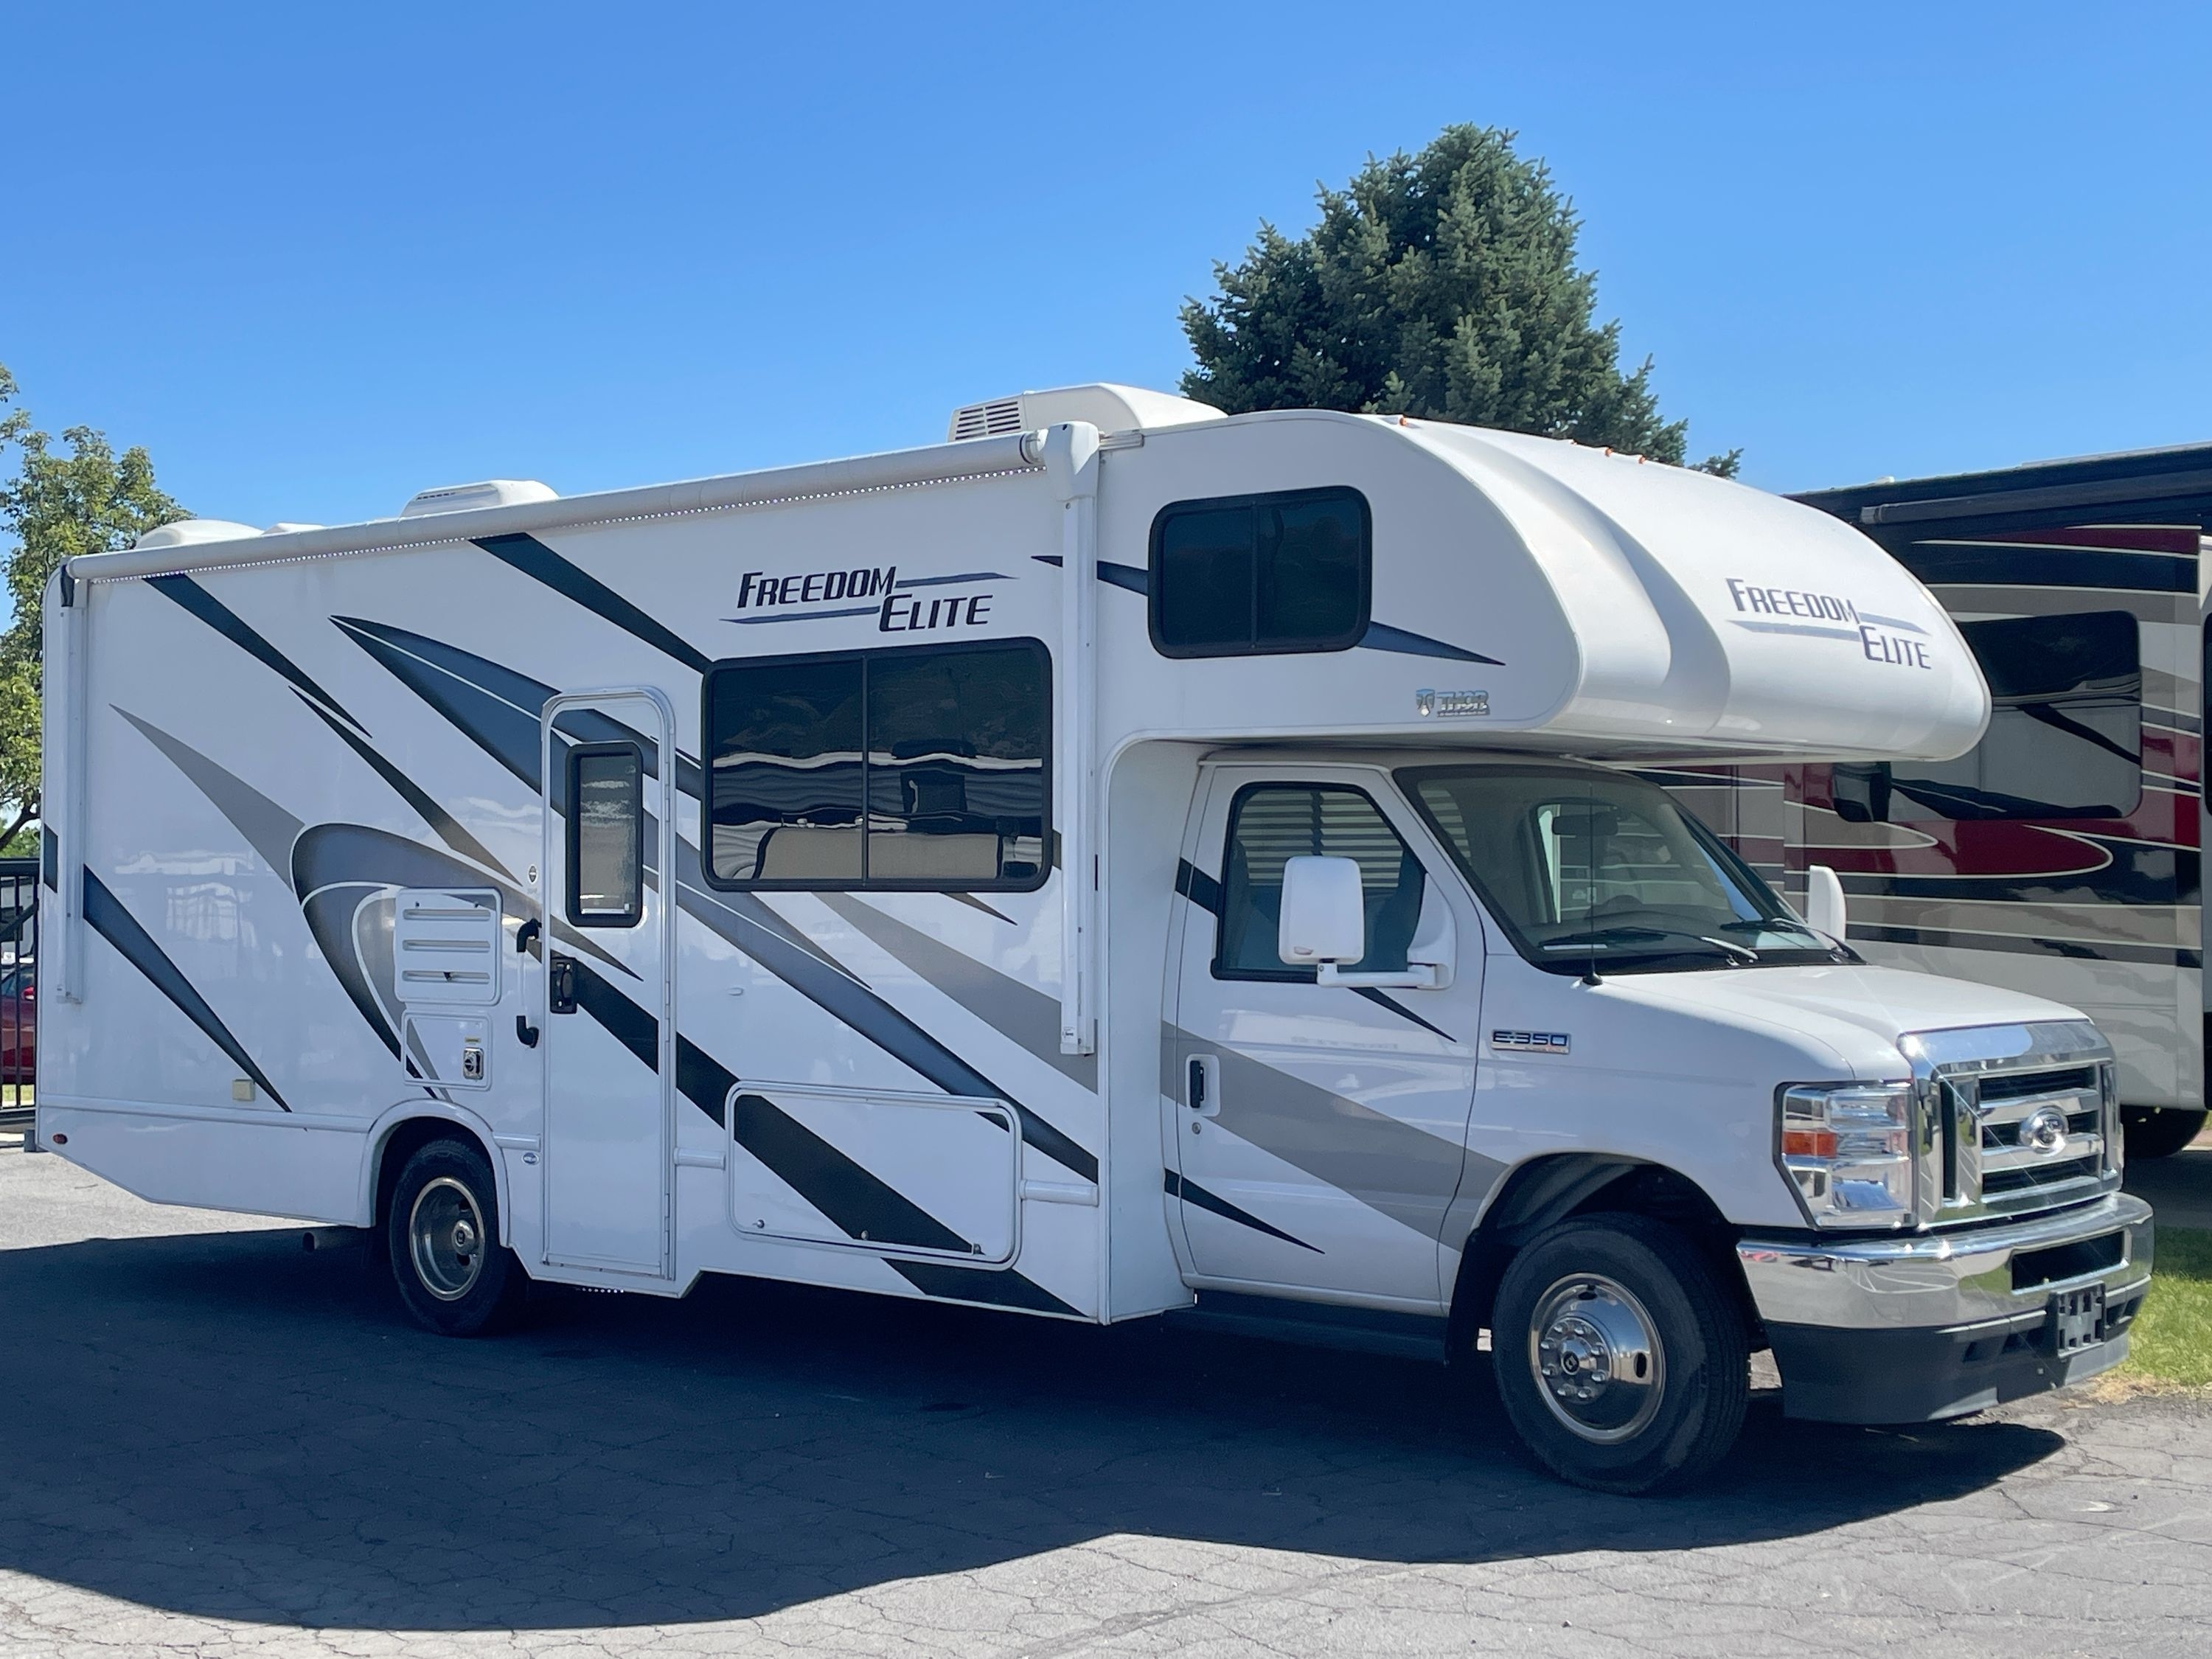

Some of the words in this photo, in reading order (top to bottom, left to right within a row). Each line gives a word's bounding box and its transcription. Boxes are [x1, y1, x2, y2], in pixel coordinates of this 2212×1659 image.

[737, 566, 896, 608] FREEDOM
[1726, 578, 1860, 625] FREEDOM
[879, 594, 993, 632] ELITE
[1859, 625, 1931, 669] ELITE
